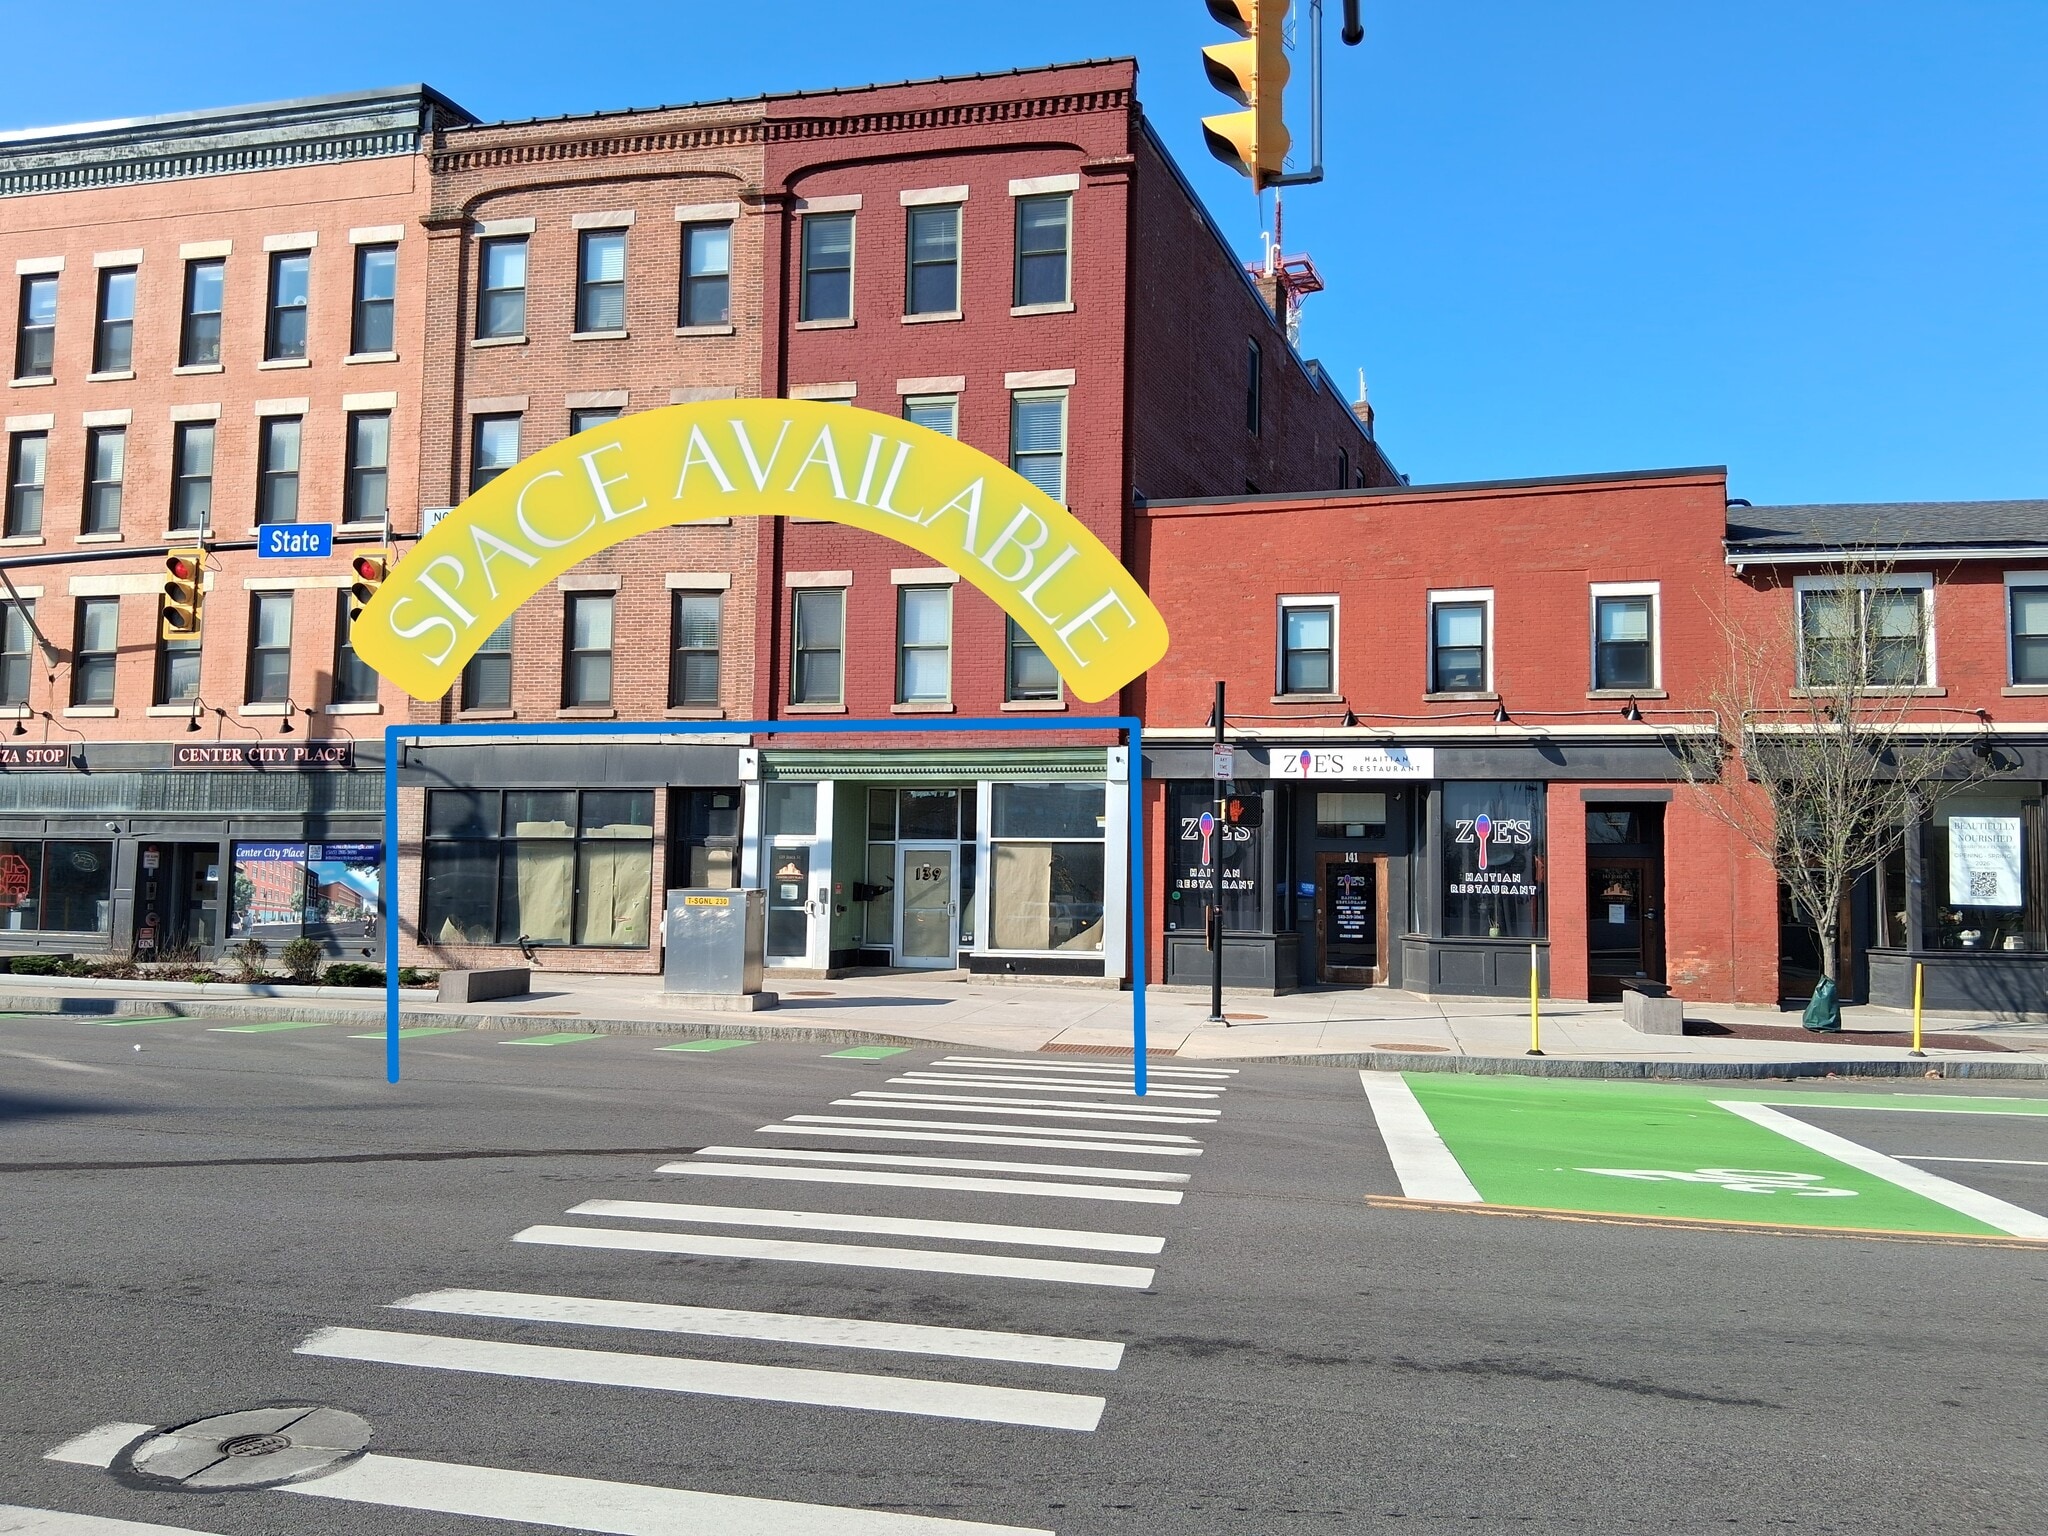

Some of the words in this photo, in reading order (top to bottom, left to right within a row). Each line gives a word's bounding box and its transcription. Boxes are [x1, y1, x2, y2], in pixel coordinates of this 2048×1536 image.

[270, 530, 320, 552] State
[0, 749, 20, 763] ZA
[26, 749, 64, 763] STOP
[178, 748, 243, 762] CENTER
[248, 747, 288, 762] CITY
[293, 747, 346, 762] PLACE
[1954, 822, 2016, 831] BEAUTIFULLY
[1959, 834, 2013, 843] NOURISHED
[236, 848, 261, 857] Center
[263, 847, 281, 860] City
[282, 847, 305, 858] Place
[1344, 852, 1359, 863] 141
[915, 867, 942, 881] 139
[1189, 868, 1241, 877] HAIAN
[1465, 872, 1521, 882] HAITIAN
[1176, 879, 1255, 890] RESTARANT
[1450, 884, 1537, 895] RESTAURANT
[688, 897, 712, 905] T-SGNL
